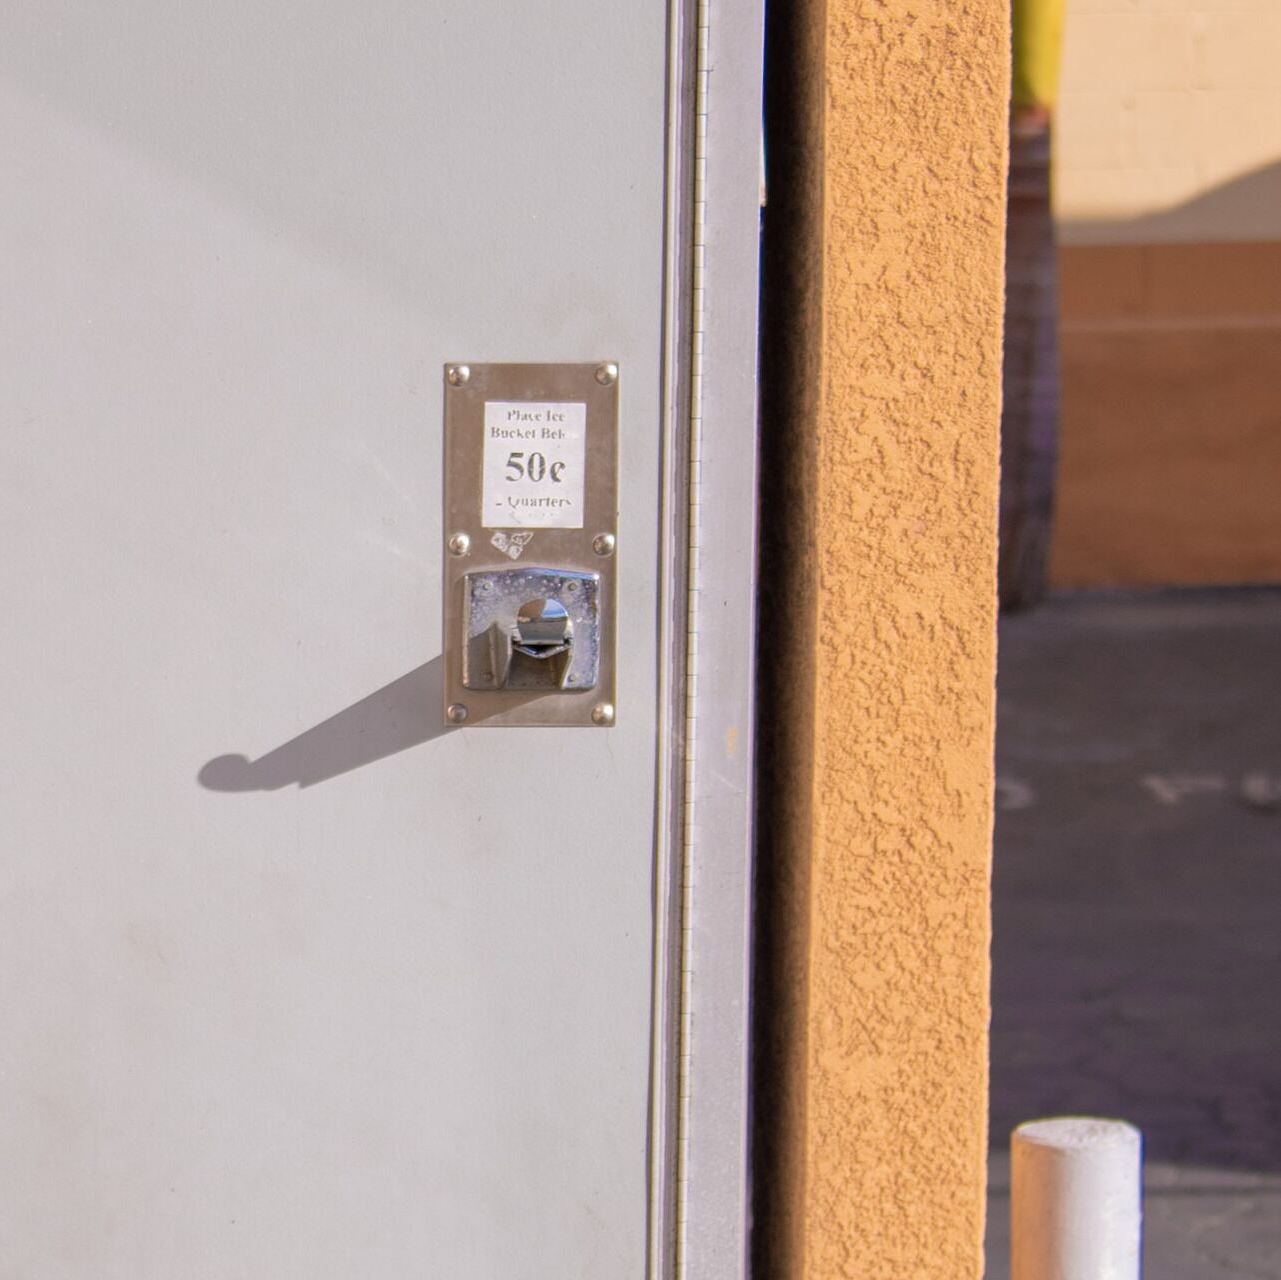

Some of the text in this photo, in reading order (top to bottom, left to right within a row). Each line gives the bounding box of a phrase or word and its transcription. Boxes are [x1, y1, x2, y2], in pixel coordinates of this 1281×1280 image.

[507, 409, 566, 422] Place Ice
[491, 426, 536, 439] Bucket
